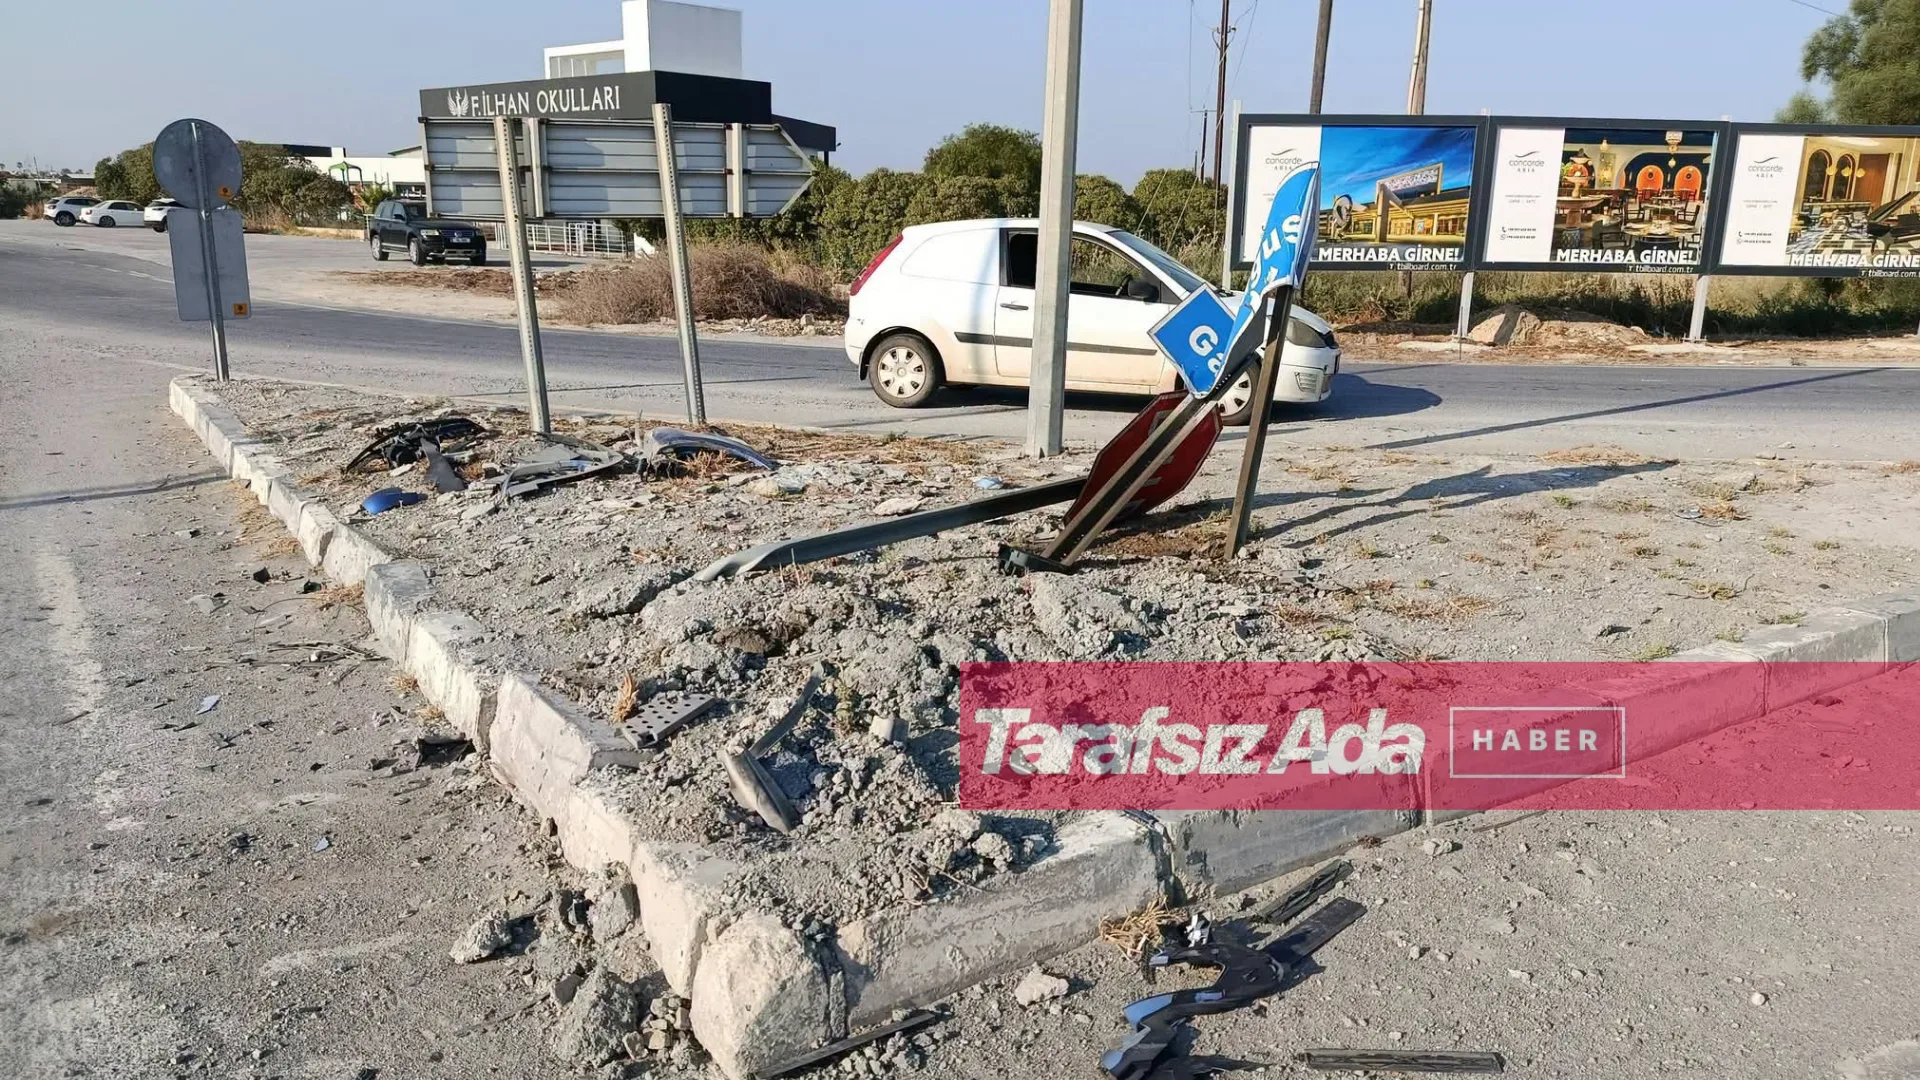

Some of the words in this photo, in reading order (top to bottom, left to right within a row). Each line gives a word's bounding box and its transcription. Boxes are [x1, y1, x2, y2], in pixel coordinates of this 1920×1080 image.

[537, 85, 620, 114] OKULLARI
[1265, 157, 1302, 165] concorde
[1508, 159, 1545, 167] concorde
[1748, 164, 1784, 173] concorde
[1318, 246, 1400, 262] MERHABA
[1404, 243, 1460, 262] GİRNE!
[1555, 248, 1637, 264] MERHABA
[1640, 245, 1694, 265] GİRNE!
[1790, 253, 1870, 268] MERHABA
